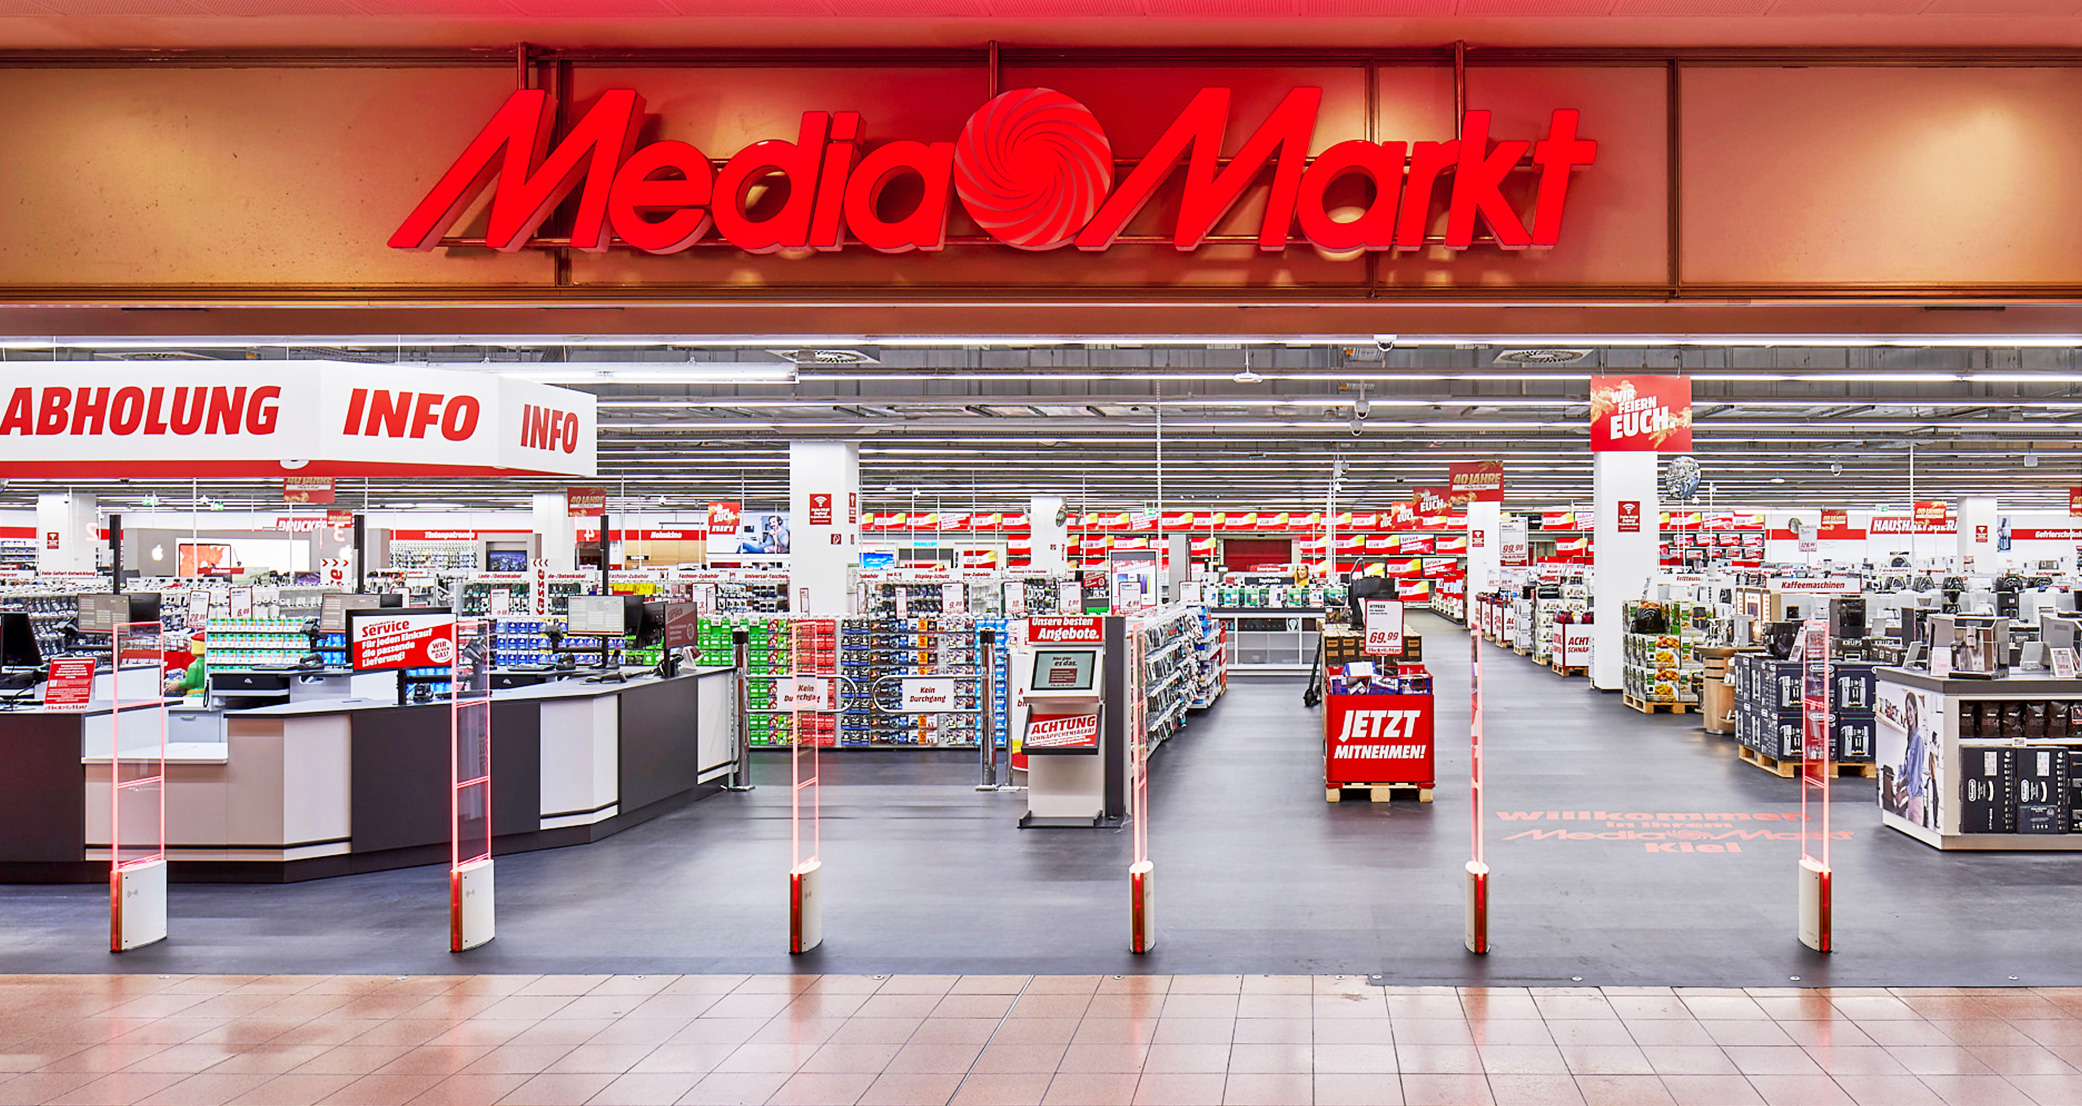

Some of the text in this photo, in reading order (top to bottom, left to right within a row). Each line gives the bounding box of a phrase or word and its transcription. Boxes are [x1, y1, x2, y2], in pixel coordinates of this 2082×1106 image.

[387, 86, 1598, 252] Media Markt
[1611, 388, 1635, 404] WIR
[2, 386, 281, 436] ABHOLUNG
[1618, 396, 1657, 415] FEIERN
[343, 388, 480, 442] INFO
[1610, 406, 1676, 440] EUCH.
[520, 403, 578, 454] INFO
[1468, 472, 1502, 484] JAHRE
[1781, 580, 1845, 589] Kaffeemaschinen
[362, 620, 410, 638] Service
[1031, 616, 1094, 626] Unsere besten
[362, 627, 433, 650] Für jeden Einkauf
[1037, 627, 1100, 642] Angebote.
[1369, 631, 1400, 644] 69.99
[362, 641, 416, 658] die passende
[432, 641, 447, 649] WIR
[362, 651, 406, 668] Lieferung!
[797, 684, 815, 692] Kein
[909, 694, 946, 703] Durchgang
[1031, 715, 1096, 736] ACHTUNG
[1338, 709, 1421, 743] JETZT
[1333, 745, 1426, 759] MITNEHMEN!
[1496, 811, 1811, 821] Willkommen
[1502, 829, 1670, 841] Media
[1644, 842, 1742, 853] Kiel
